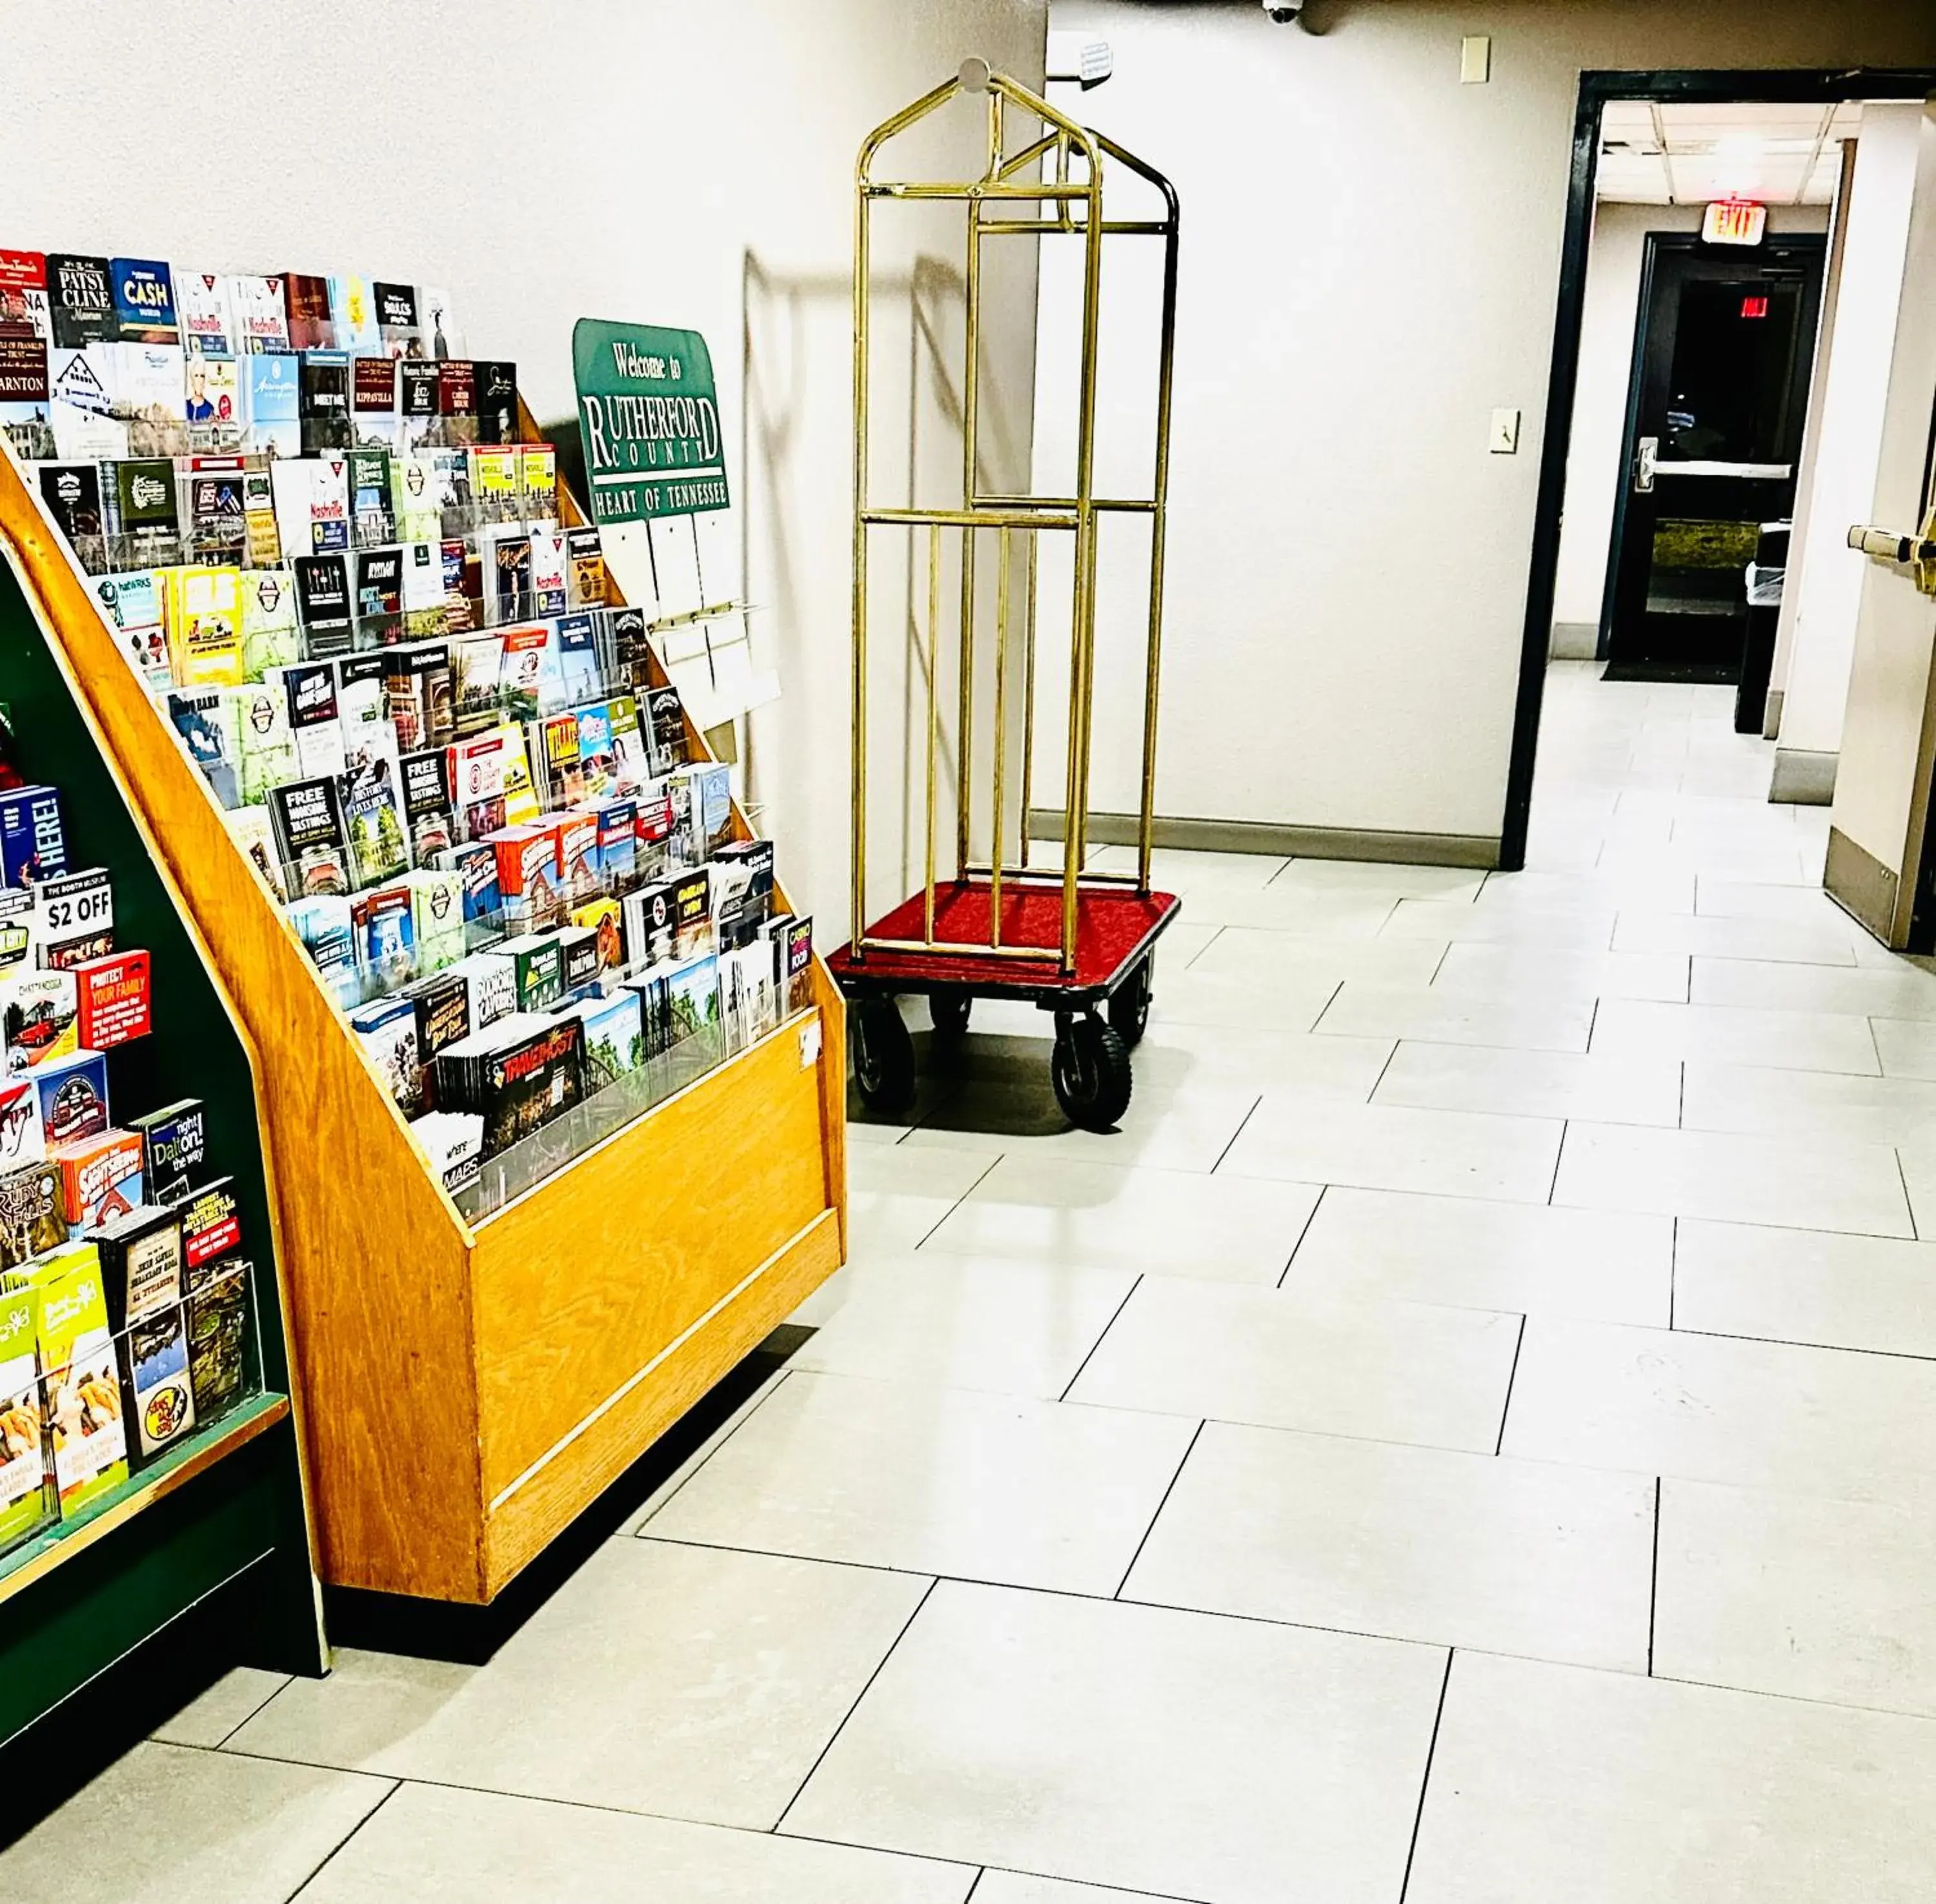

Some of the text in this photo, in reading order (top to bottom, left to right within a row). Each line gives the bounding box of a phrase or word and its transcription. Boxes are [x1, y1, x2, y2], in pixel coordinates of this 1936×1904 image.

[1716, 207, 1760, 238] EXIT
[59, 272, 105, 291] PATSY
[124, 281, 168, 307] CASH
[62, 289, 111, 308] CLINE
[614, 343, 681, 380] Welcome to
[583, 395, 719, 469] RUTHERFORD
[612, 441, 703, 467] COUNTY
[310, 500, 343, 520] Nashville
[595, 482, 727, 516] HEART OF TENNESSEE
[407, 758, 438, 778] FREE
[285, 785, 326, 808] FREE
[31, 798, 66, 868] HERE!
[290, 813, 332, 833] TASTINGS
[48, 886, 60, 896] THE
[83, 875, 107, 888] MUSEUM
[48, 902, 72, 929] $2
[77, 891, 109, 921] OFF
[792, 950, 809, 969] FOOD
[90, 966, 124, 991] PROTECT
[92, 976, 146, 1006] YOUR FAMILY
[172, 1147, 204, 1172] the way
[446, 1140, 468, 1160] where
[443, 1157, 479, 1188] MAPS
